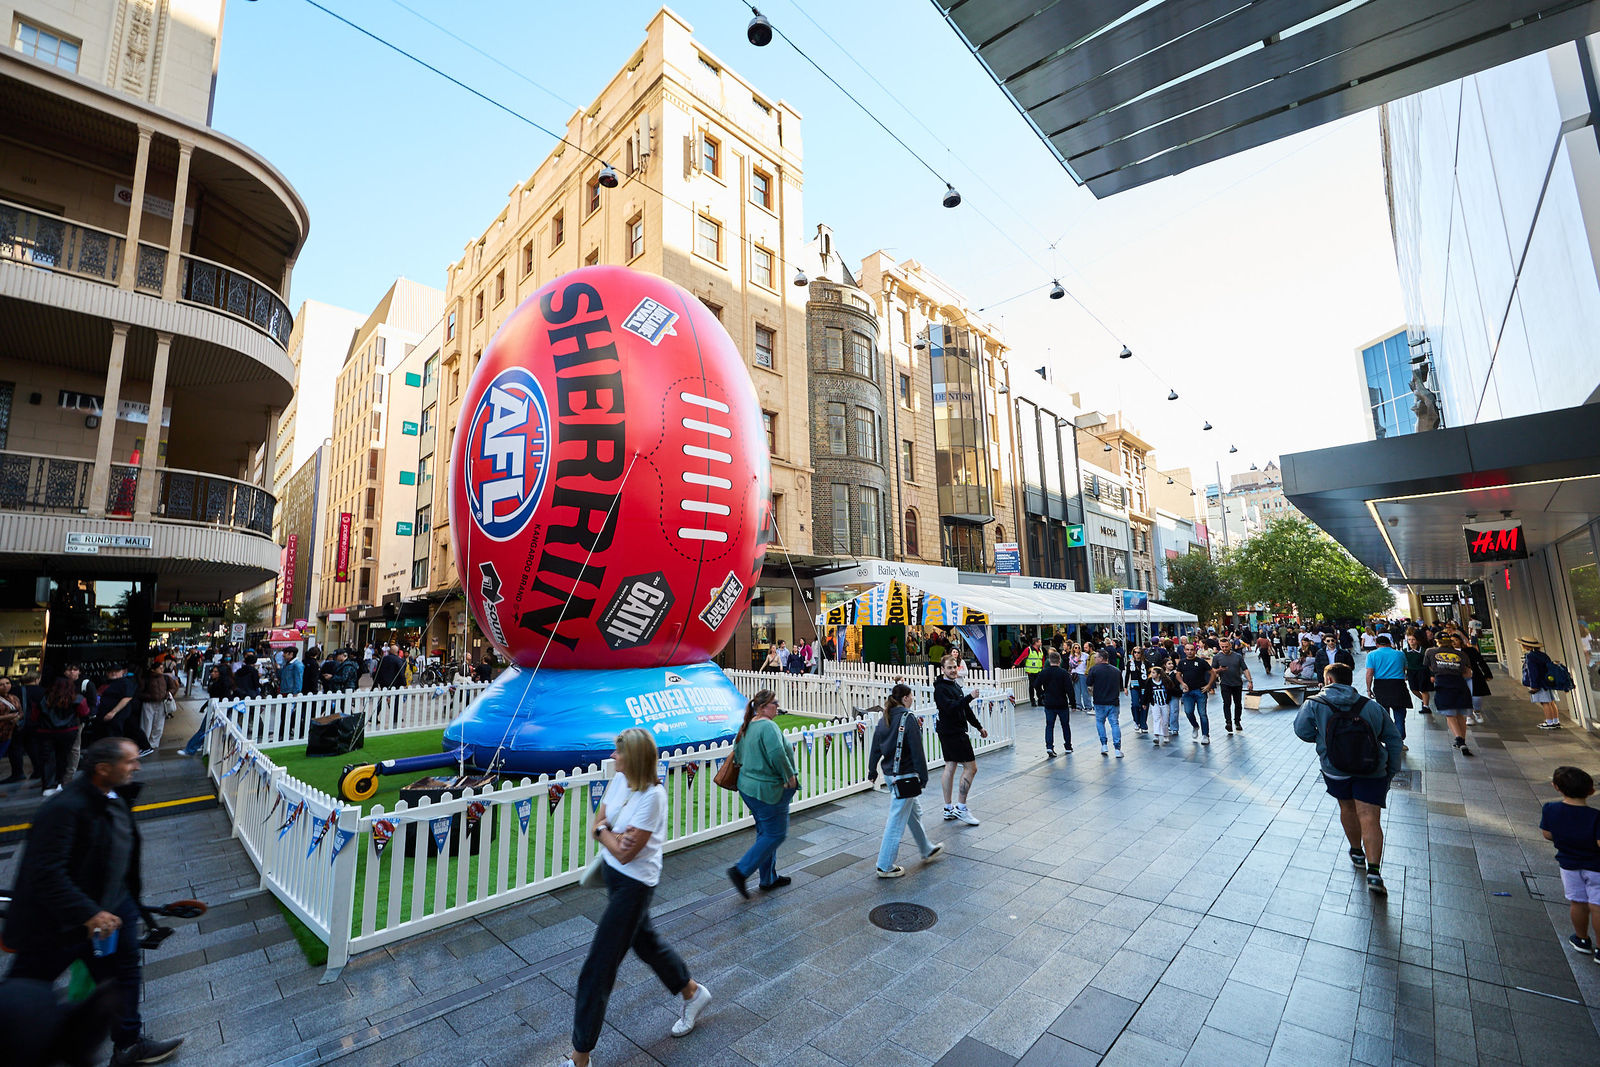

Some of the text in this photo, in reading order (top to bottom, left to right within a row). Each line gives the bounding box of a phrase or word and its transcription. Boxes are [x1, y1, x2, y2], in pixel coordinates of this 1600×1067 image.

[626, 300, 658, 328] OVAL
[482, 386, 529, 526] AFL
[519, 282, 626, 652] SHERRIN
[84, 535, 147, 546] RUNDLE MALL
[288, 535, 297, 561] CITY
[1471, 527, 1519, 554] H&M
[515, 523, 542, 602] KANGAROO BRAND
[878, 564, 920, 578] Bailey Nelson
[285, 569, 294, 603] CROSS
[706, 578, 738, 623] ADELAIDE
[1033, 580, 1067, 590] SKECHERS
[606, 581, 665, 643] GATH
[711, 587, 742, 627] OVAL
[487, 602, 508, 646] SOUTH
[625, 687, 729, 719] GATHER ROUND
[644, 708, 692, 723] FESTIVAL
[669, 721, 687, 729] SOUTH
